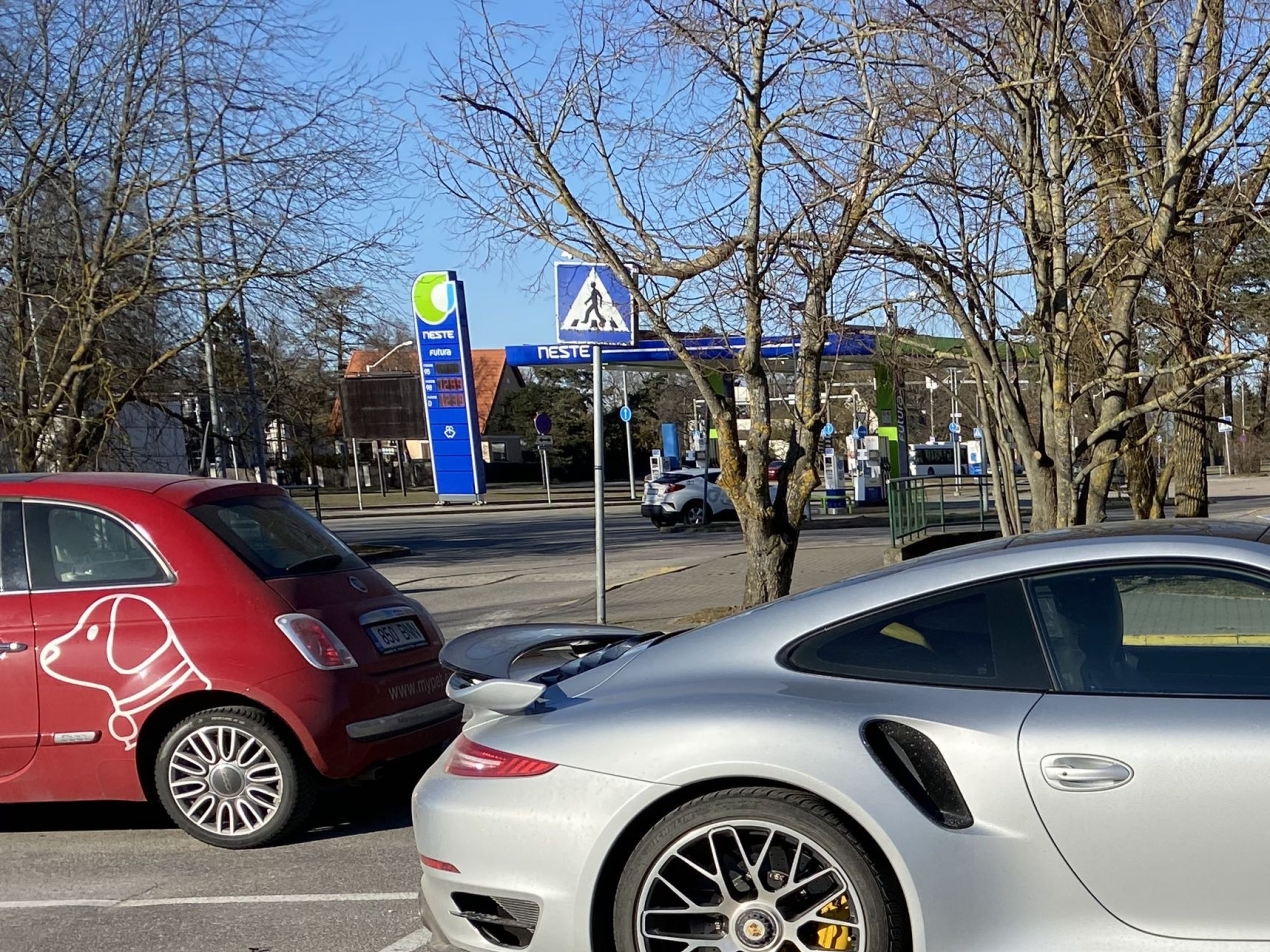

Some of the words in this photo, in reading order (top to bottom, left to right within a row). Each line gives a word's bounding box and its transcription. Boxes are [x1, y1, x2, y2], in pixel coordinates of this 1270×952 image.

[422, 330, 455, 339] NESTE
[538, 345, 591, 360] NESTE
[377, 626, 401, 645] 850
